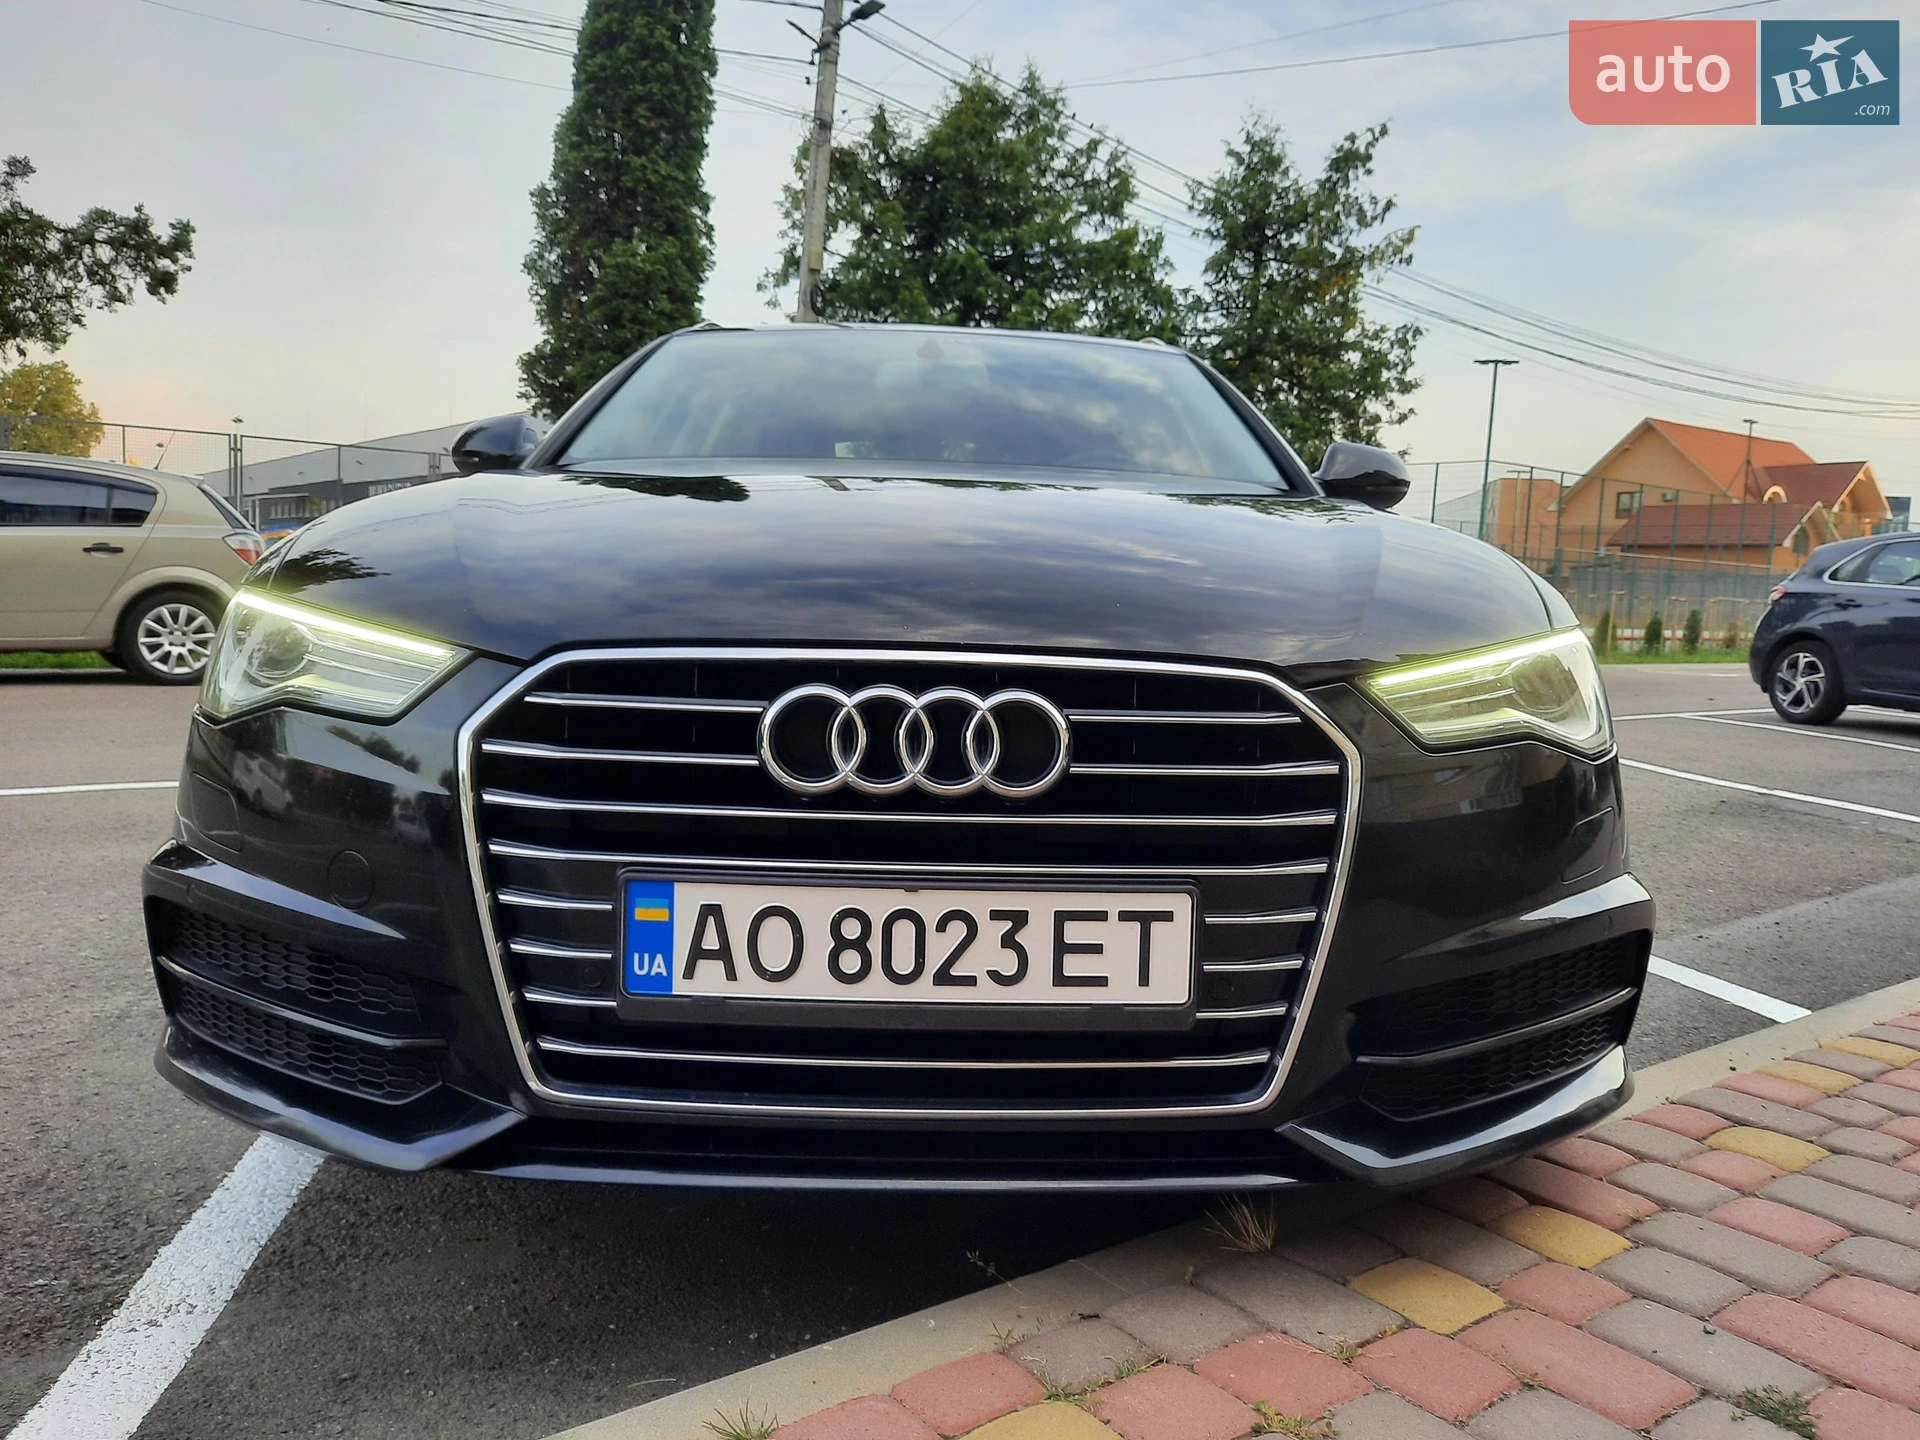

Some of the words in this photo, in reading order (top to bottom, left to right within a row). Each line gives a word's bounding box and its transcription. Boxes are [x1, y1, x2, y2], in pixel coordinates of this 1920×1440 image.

[633, 953, 667, 977] UA
[682, 903, 804, 982] AO
[827, 907, 1029, 987] 8023
[1052, 910, 1174, 987] ET
